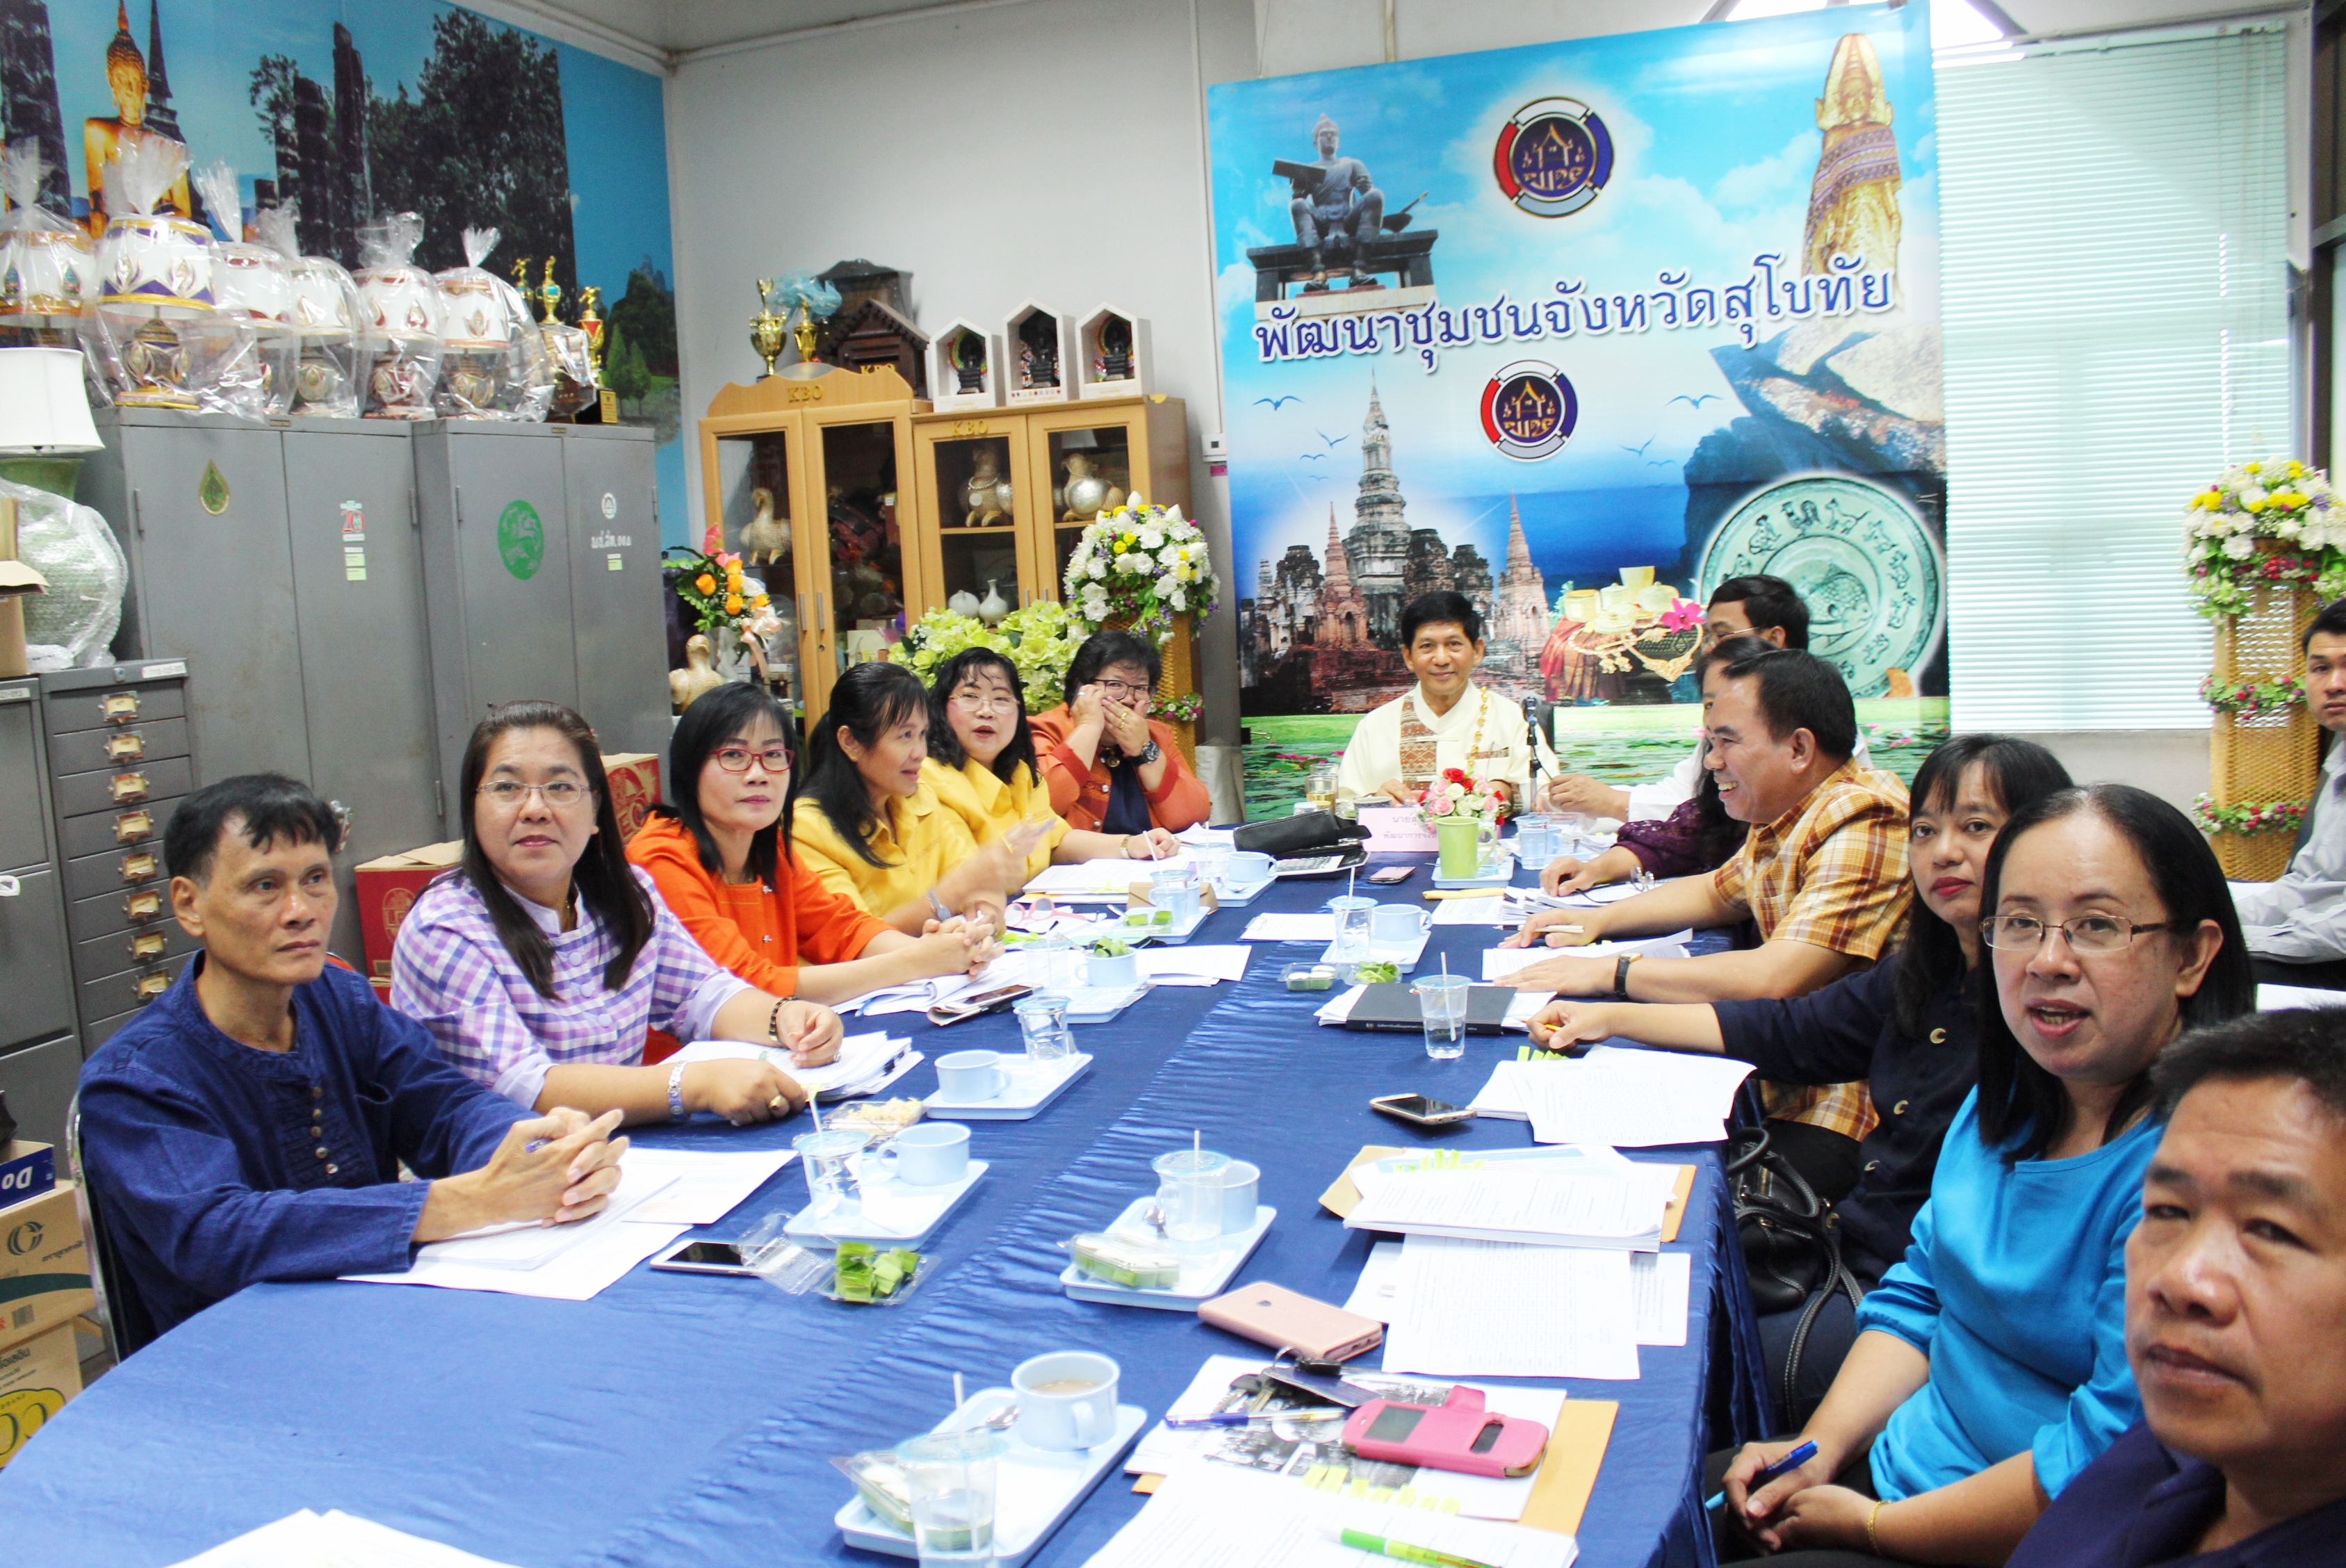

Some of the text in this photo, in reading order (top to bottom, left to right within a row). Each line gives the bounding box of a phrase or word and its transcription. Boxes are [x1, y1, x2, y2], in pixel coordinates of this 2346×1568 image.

[1257, 252, 1890, 367] พัฒนาชุมชนจังหวัดสุโขทัย
[788, 385, 823, 403] KBO
[950, 419, 988, 436] KBO
[383, 910, 406, 926] LE
